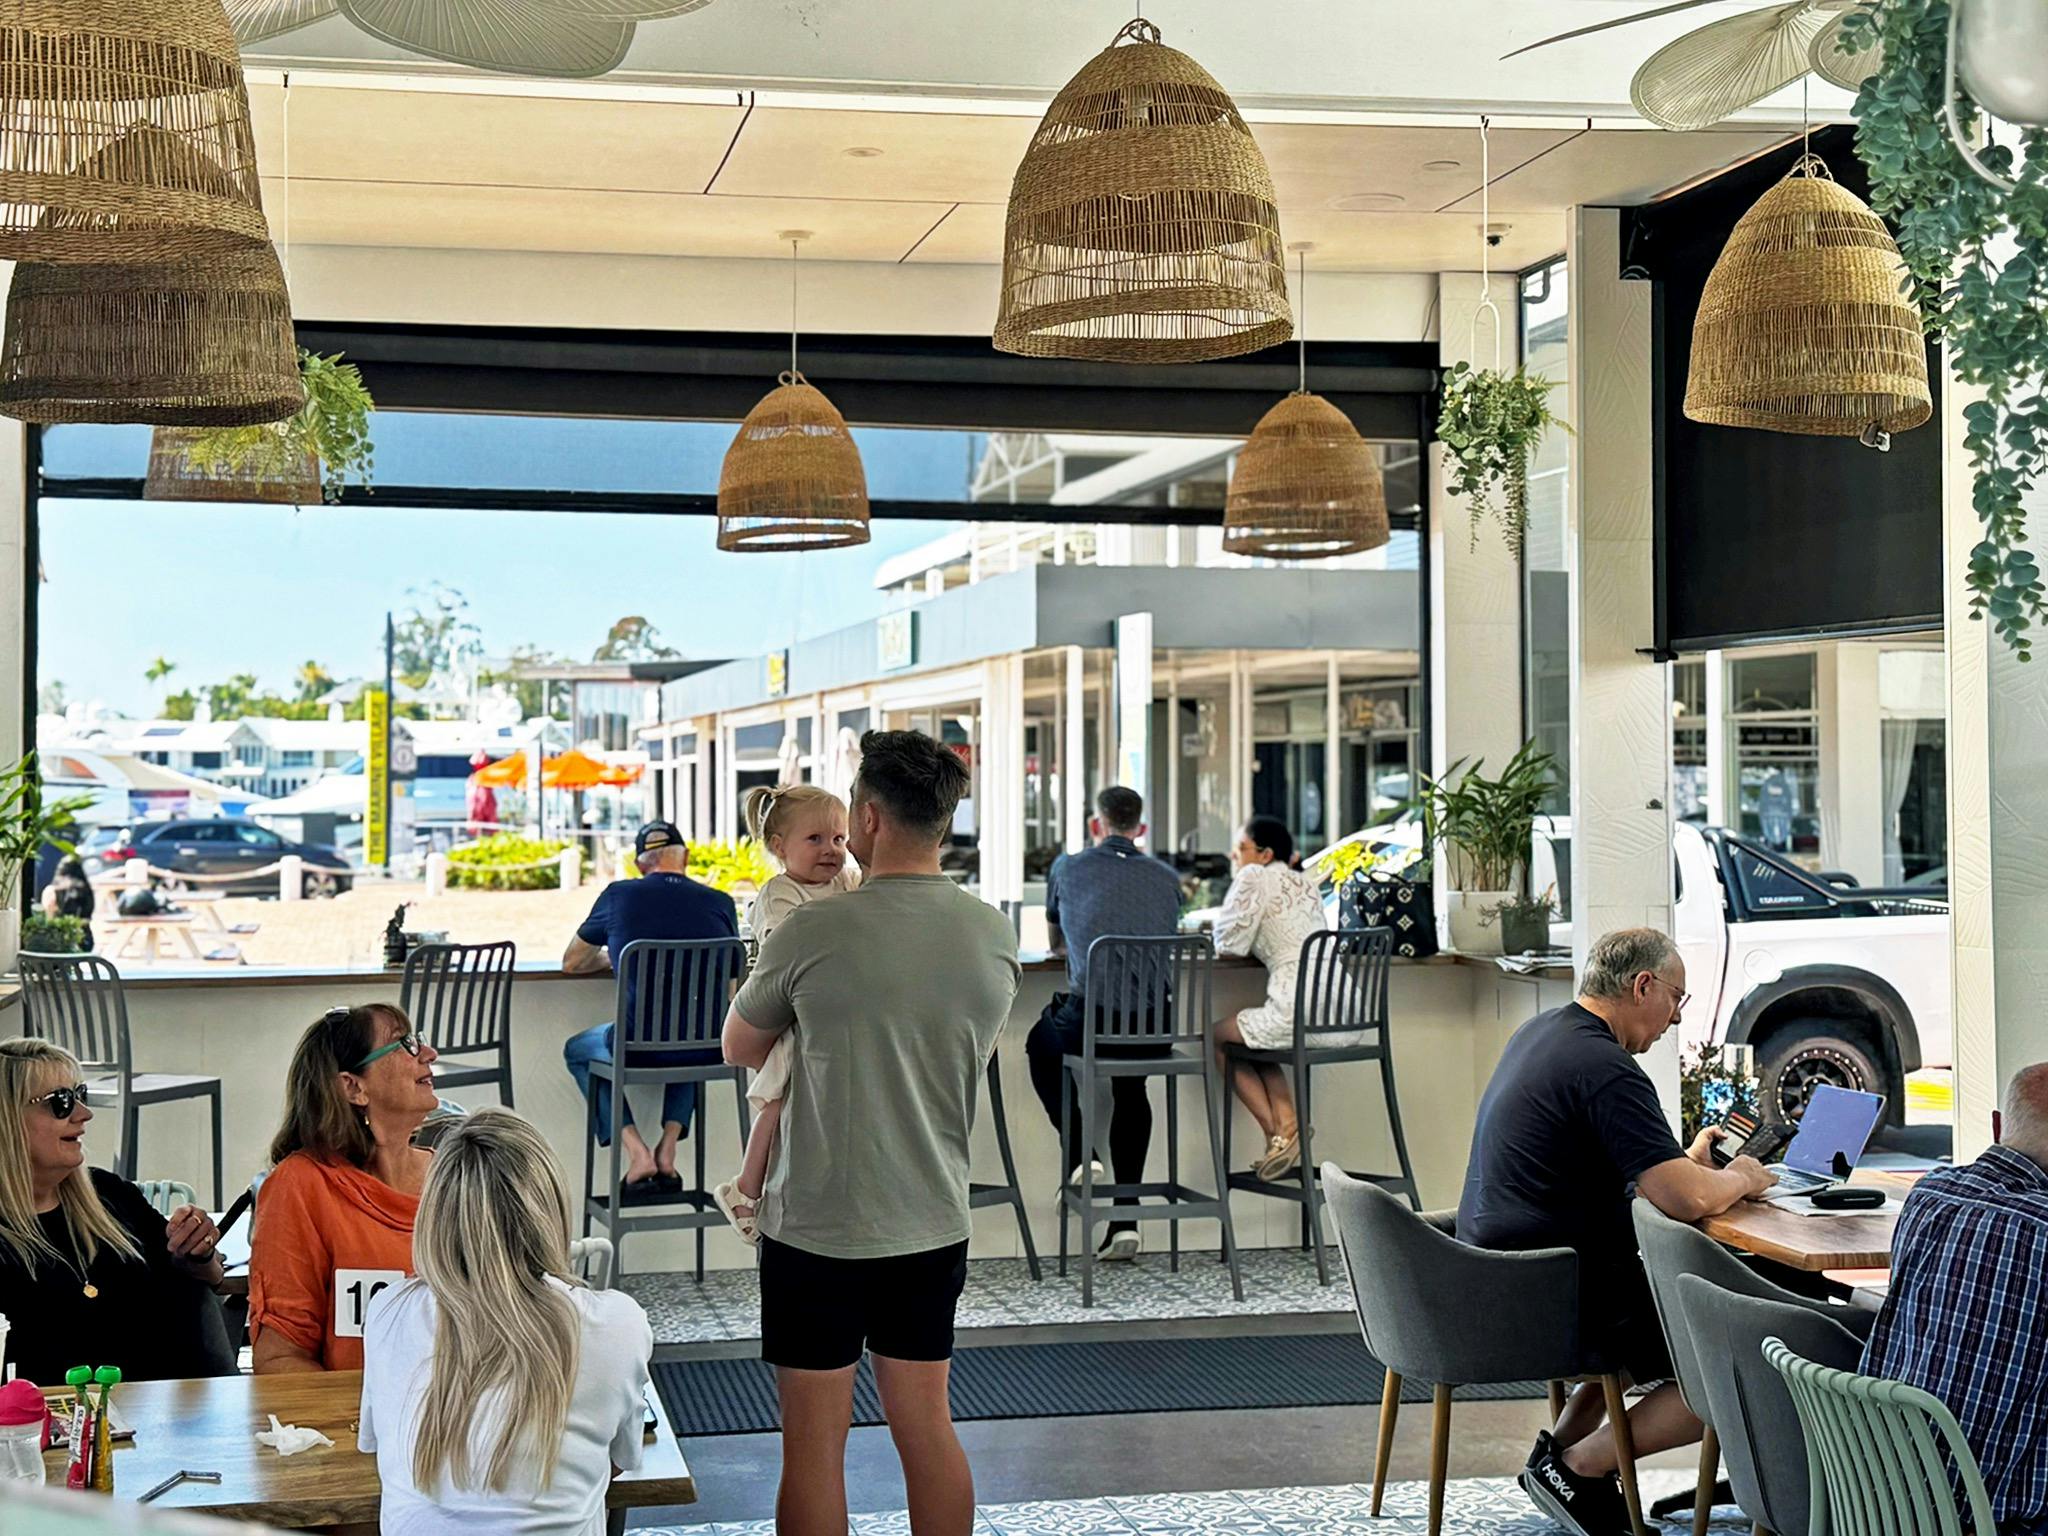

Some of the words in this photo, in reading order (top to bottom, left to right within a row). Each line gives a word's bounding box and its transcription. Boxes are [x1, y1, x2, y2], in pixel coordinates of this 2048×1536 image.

[371, 703, 383, 761] VILLAGE
[370, 831, 382, 856] THE
[347, 1280, 389, 1325] 1
[1541, 1462, 1576, 1502] HOKA
